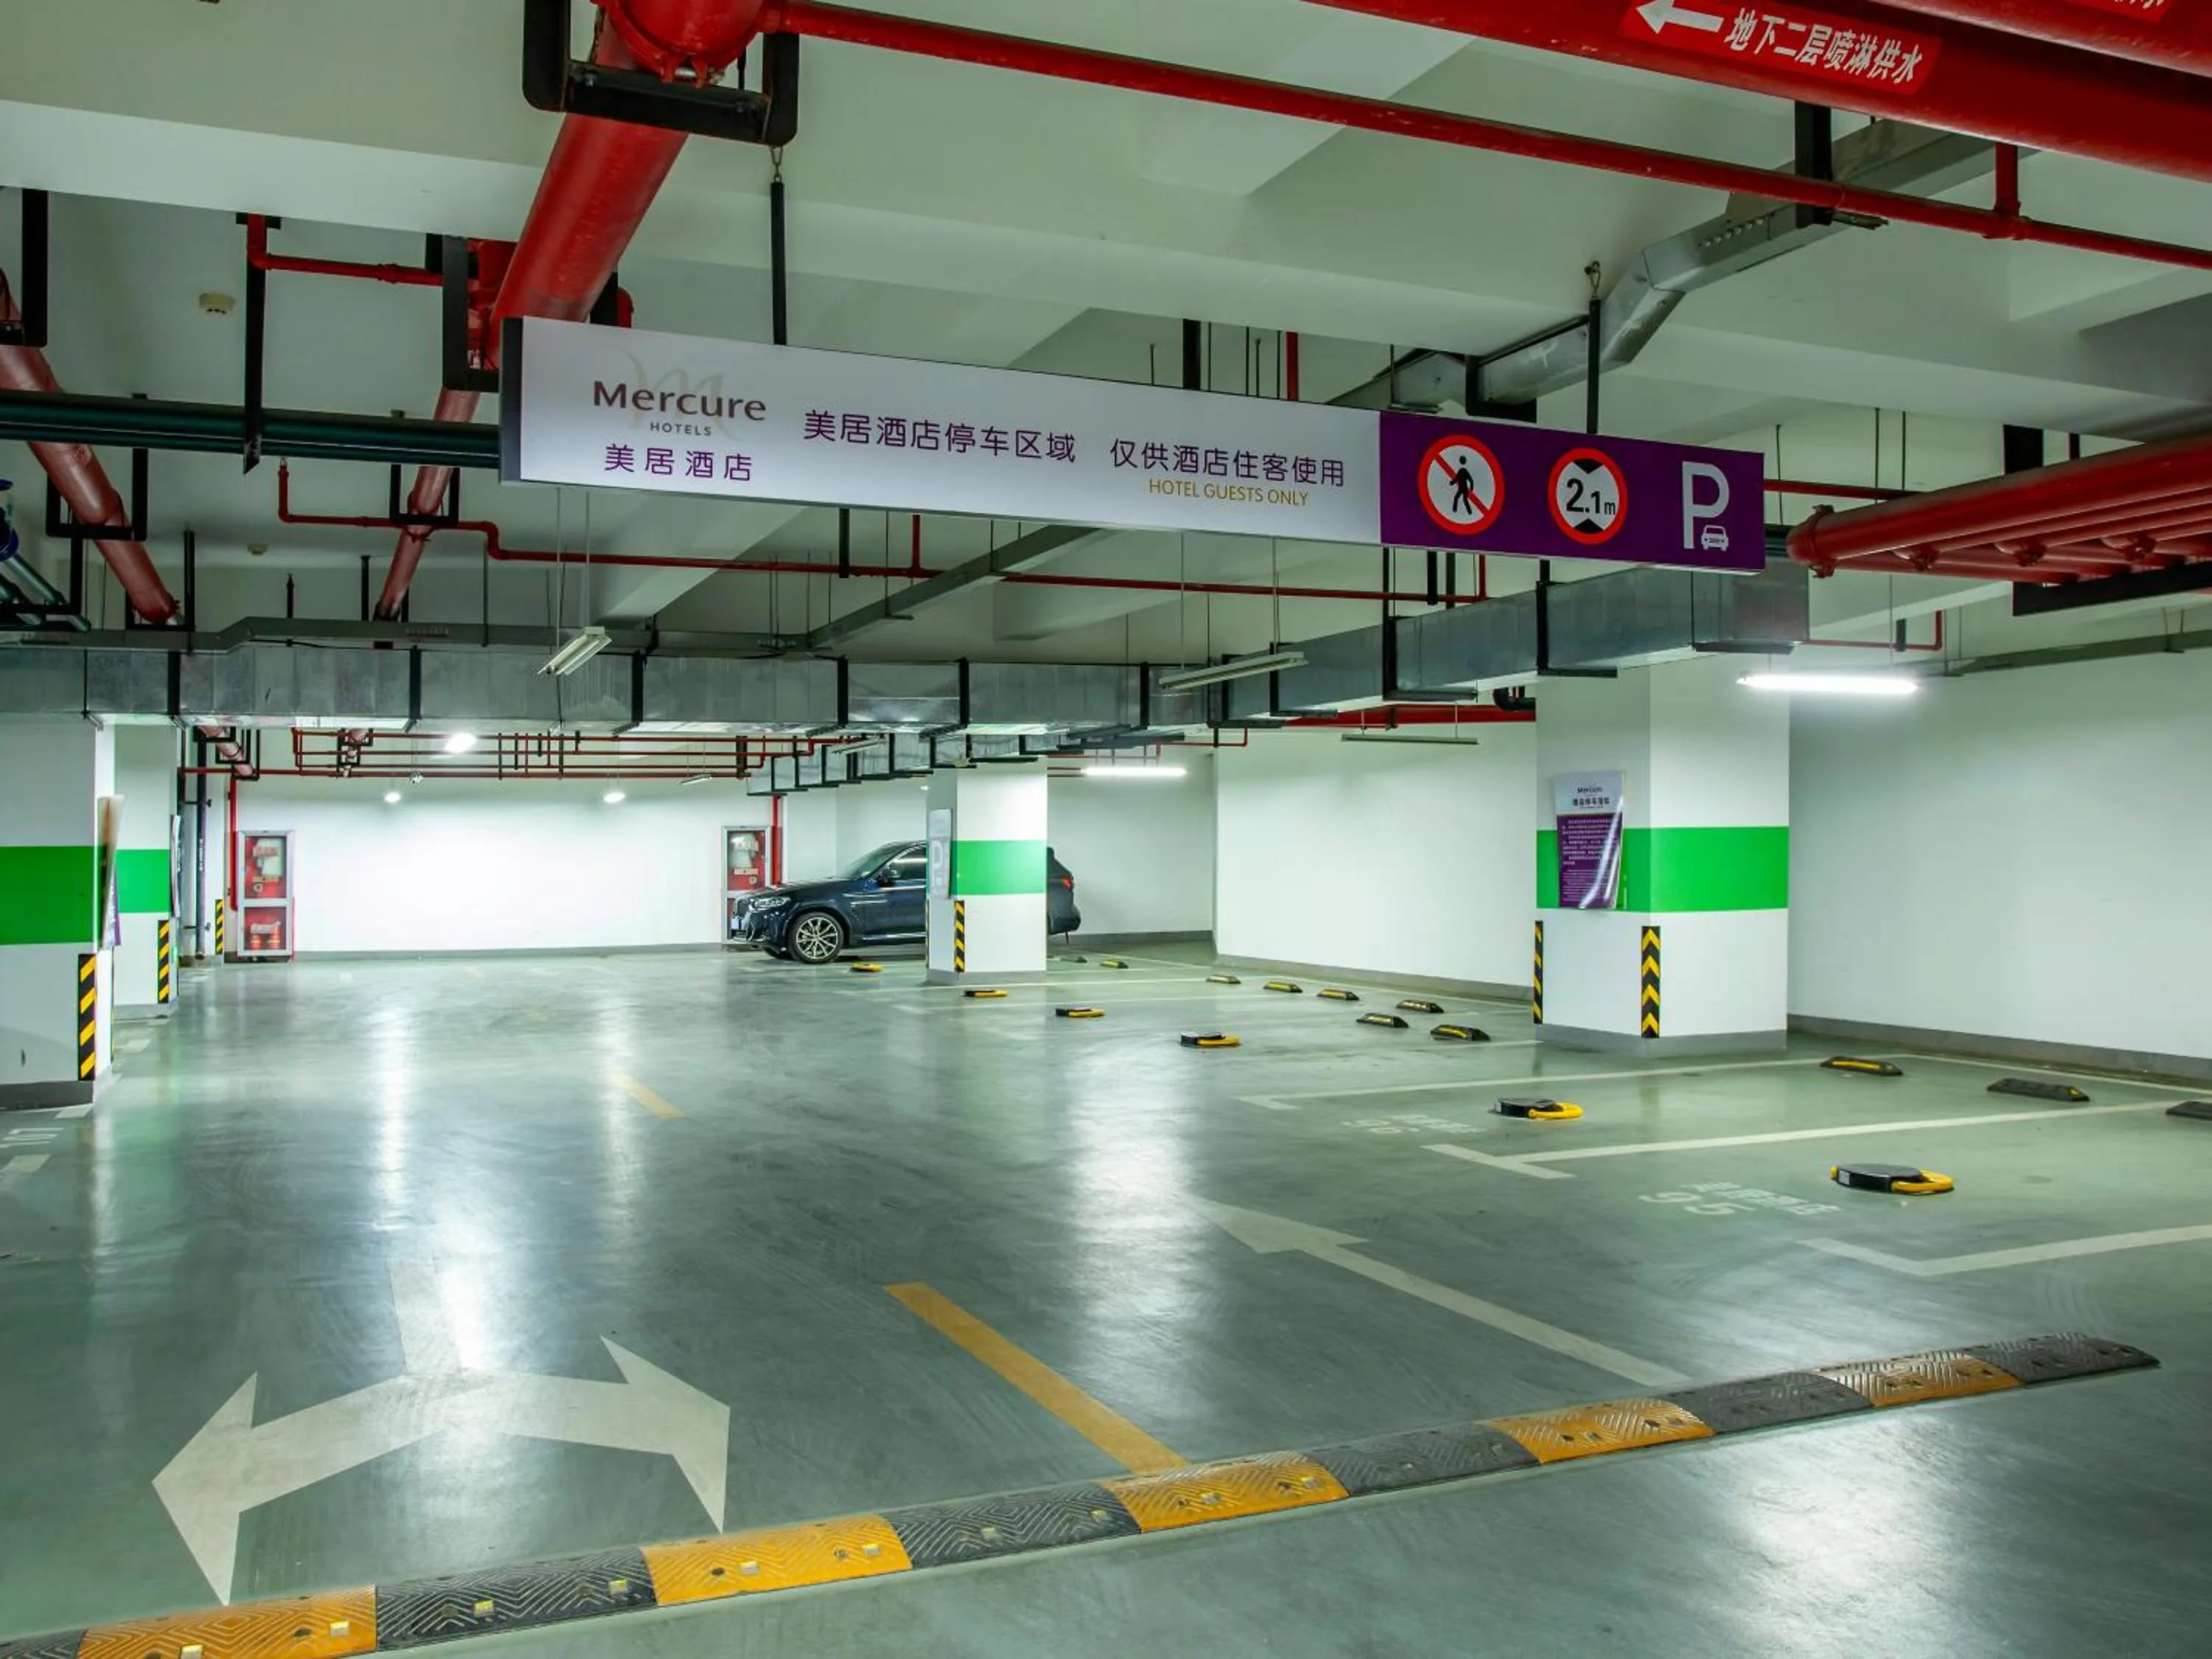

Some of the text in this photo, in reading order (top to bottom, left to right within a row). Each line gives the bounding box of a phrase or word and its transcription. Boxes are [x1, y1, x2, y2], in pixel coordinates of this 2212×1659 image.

[1725, 7, 1922, 83] 地下二层喷淋供水
[594, 380, 766, 421] Mercure
[650, 422, 712, 436] HOTELS
[803, 408, 1076, 463] 美居酒店停车区域
[603, 443, 752, 481] 美居酒店
[1110, 438, 1344, 487] 仅供酒店住客使用
[1149, 478, 1309, 506] HOTEL GUESTS ONLY
[1565, 477, 1615, 515] 2.1m
[1682, 461, 1730, 549] P
